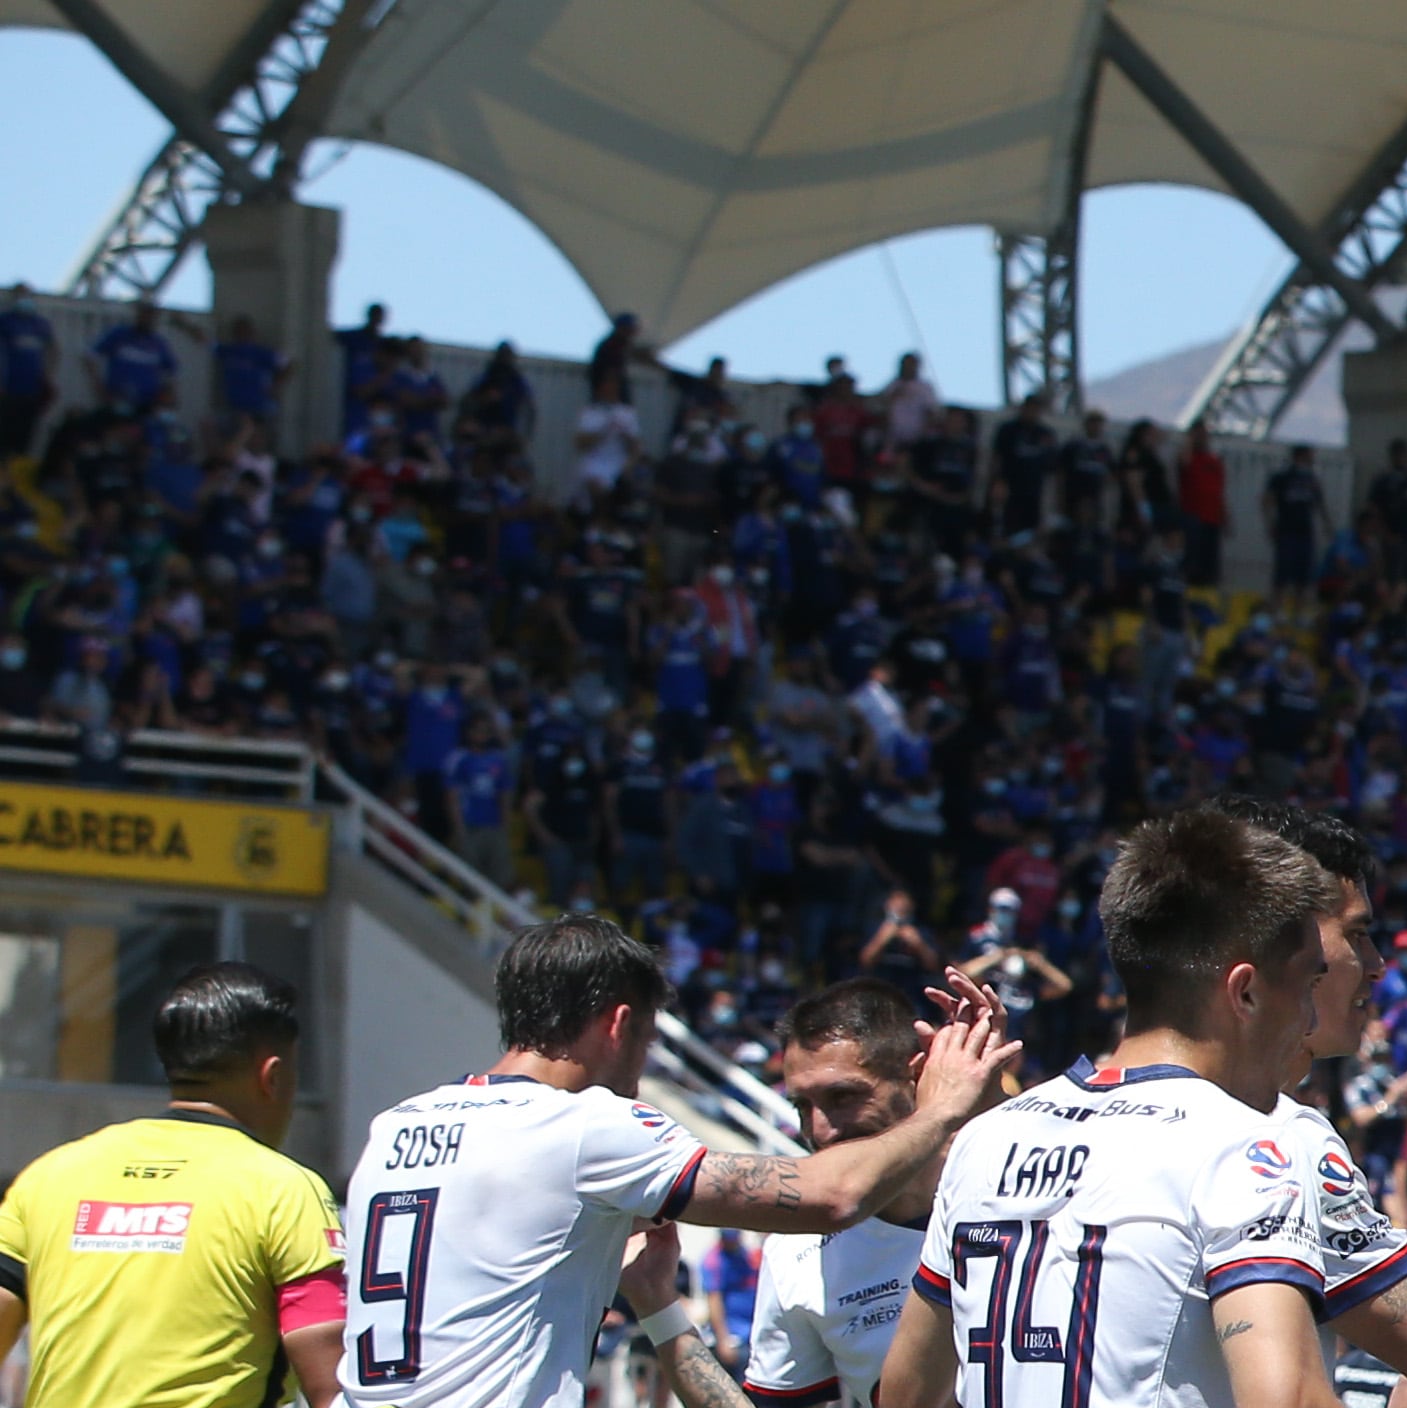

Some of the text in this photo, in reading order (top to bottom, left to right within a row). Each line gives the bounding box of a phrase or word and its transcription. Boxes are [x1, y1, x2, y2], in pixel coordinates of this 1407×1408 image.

[1100, 1100, 1164, 1117] Bus
[386, 1123, 466, 1170] SOSA
[96, 1204, 192, 1235] MTS
[358, 1187, 441, 1386] 9
[838, 1278, 900, 1306] TRAINING
